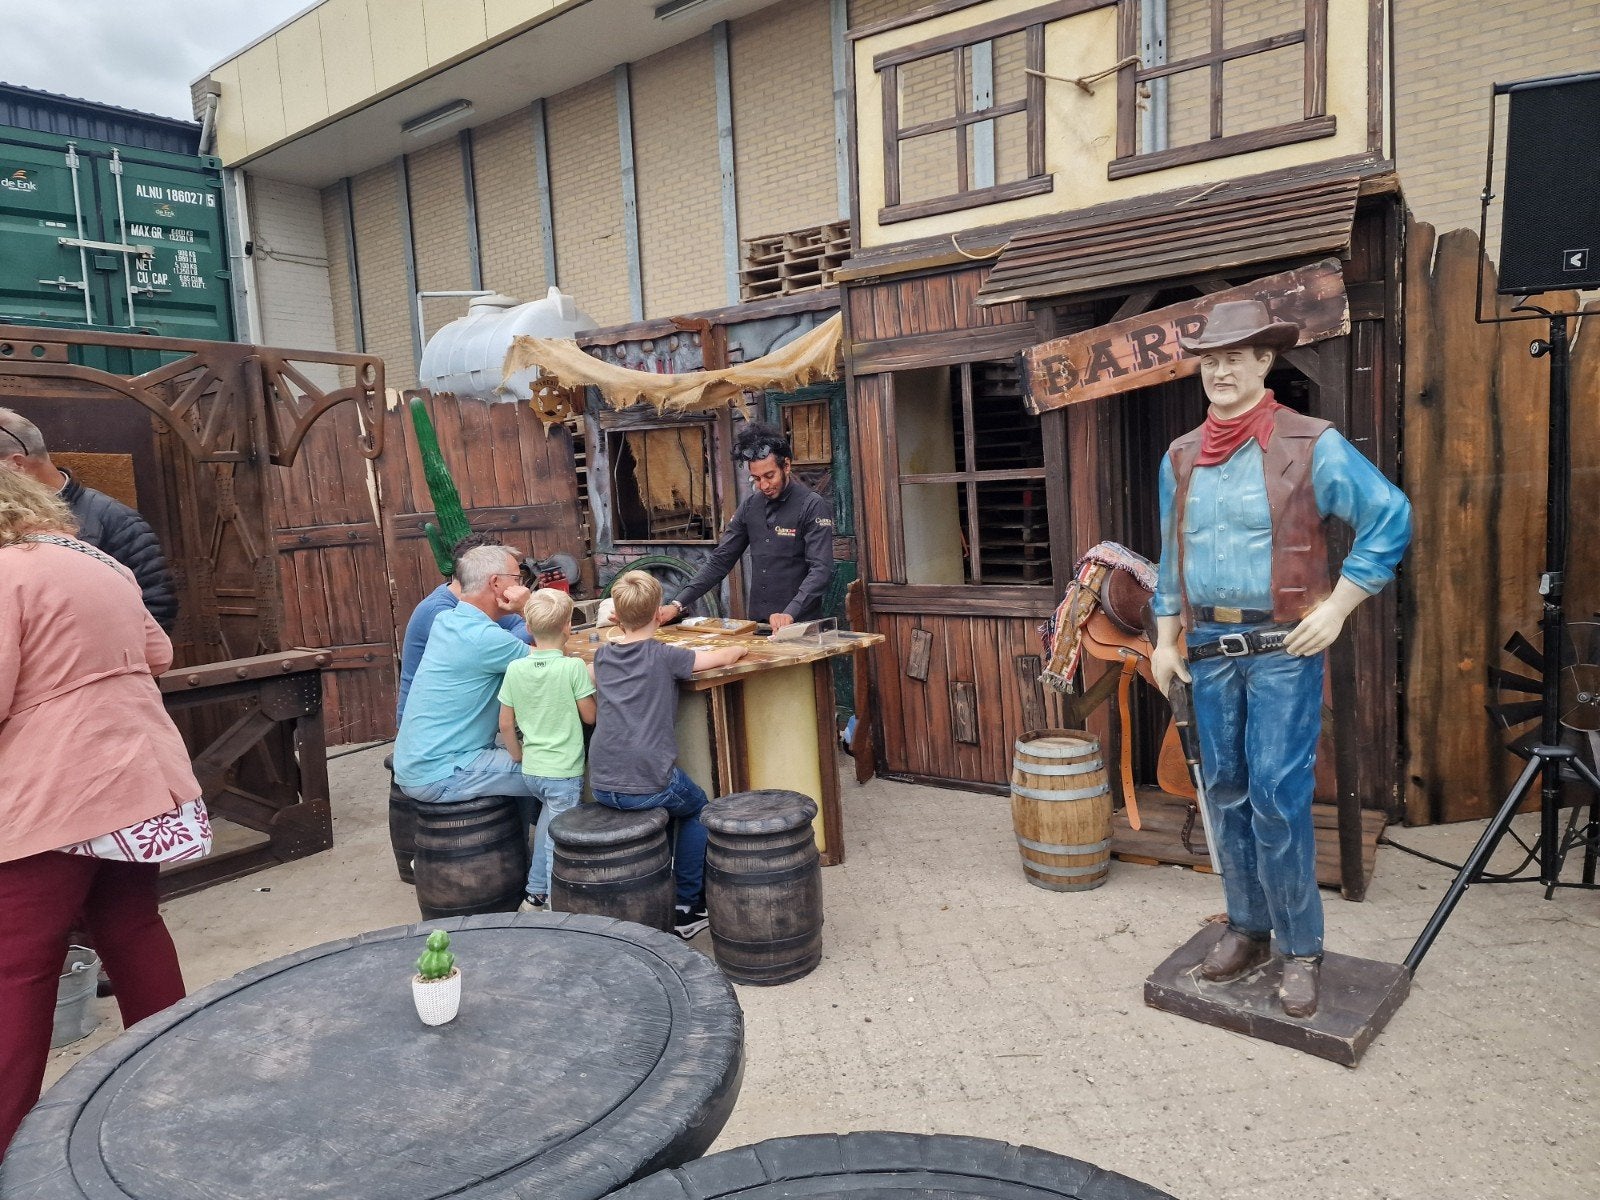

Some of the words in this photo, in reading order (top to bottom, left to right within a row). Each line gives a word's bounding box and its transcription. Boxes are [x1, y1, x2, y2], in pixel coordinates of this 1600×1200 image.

[136, 185, 163, 199] ALNU
[166, 189, 203, 204] 186027
[206, 194, 215, 207] 5
[136, 258, 152, 271] NET
